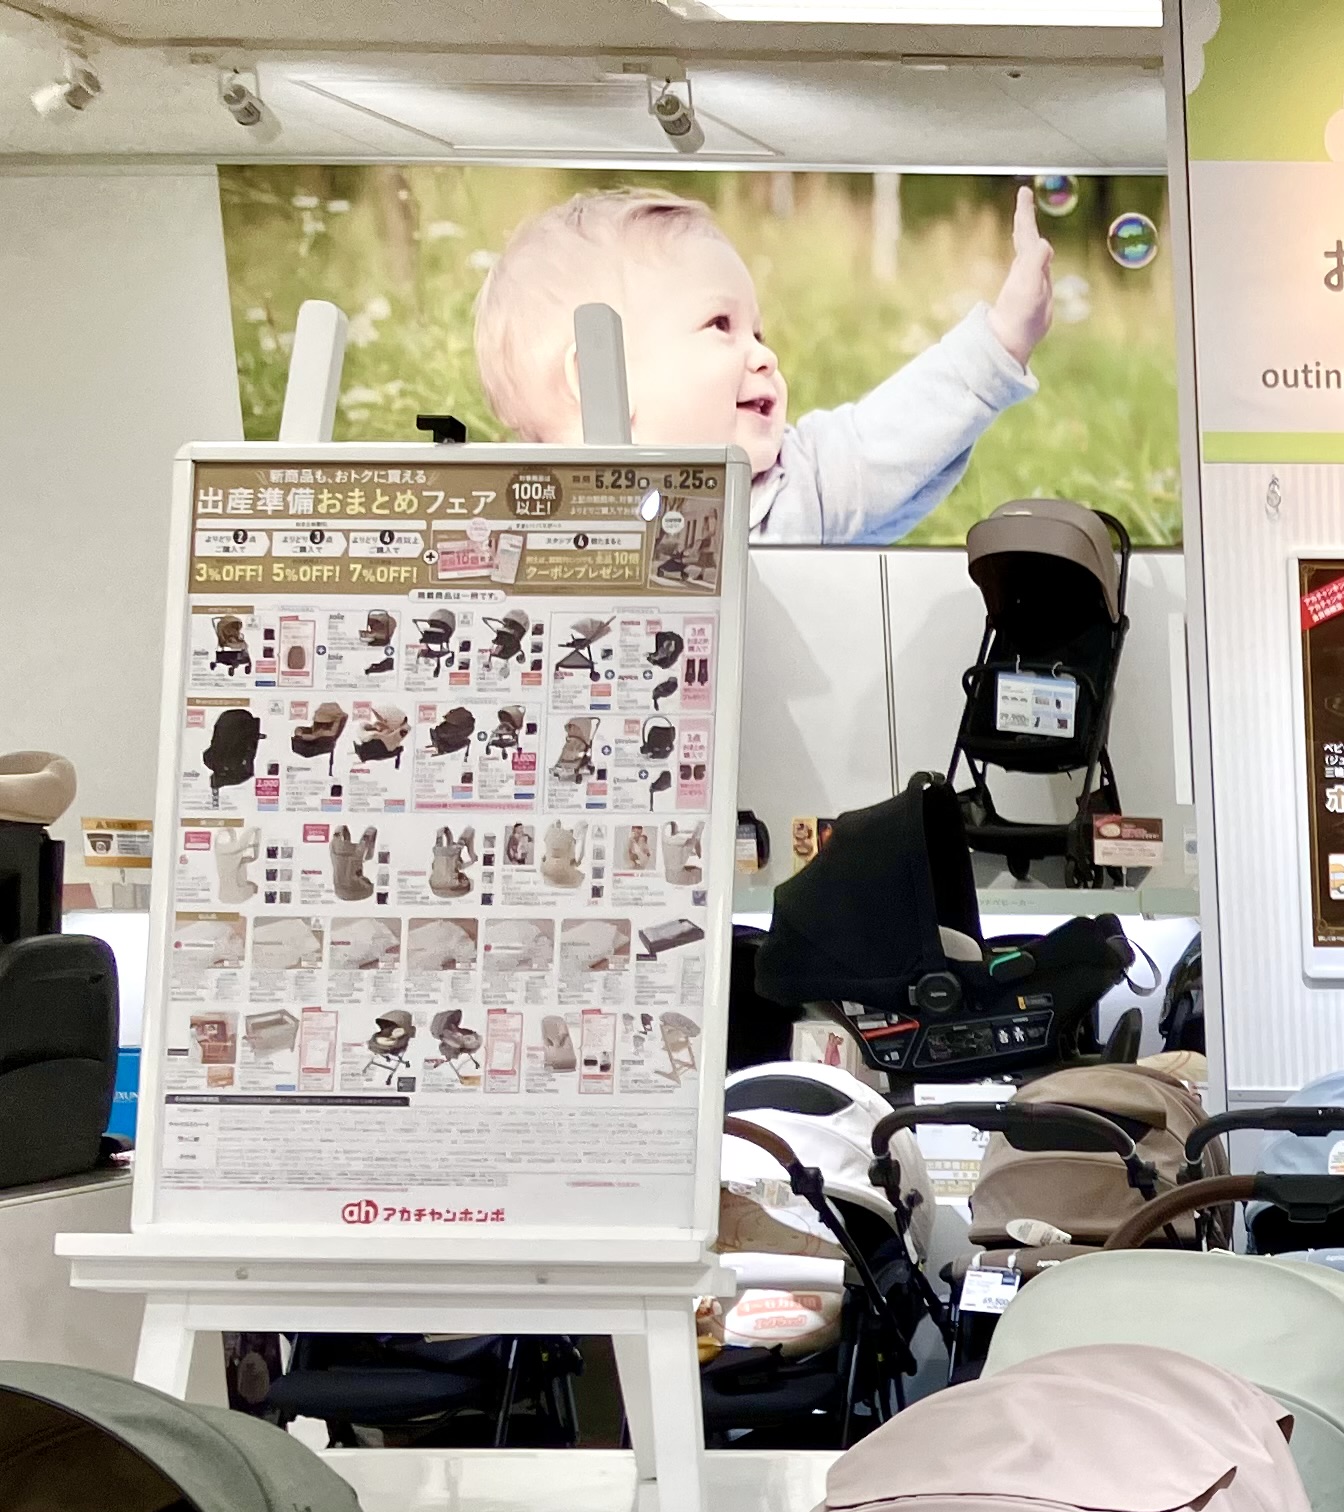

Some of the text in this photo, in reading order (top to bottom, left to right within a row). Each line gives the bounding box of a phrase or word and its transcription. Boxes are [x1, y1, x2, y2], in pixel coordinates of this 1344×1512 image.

[197, 487, 497, 516] 出産準備おまとめフェア
[511, 483, 557, 500] 100点
[195, 563, 263, 583] 3%OFF!
[271, 563, 341, 583] 5%OFF!
[348, 563, 418, 584] 7%OFF!
[382, 1207, 507, 1225] アカチャンホンポ
